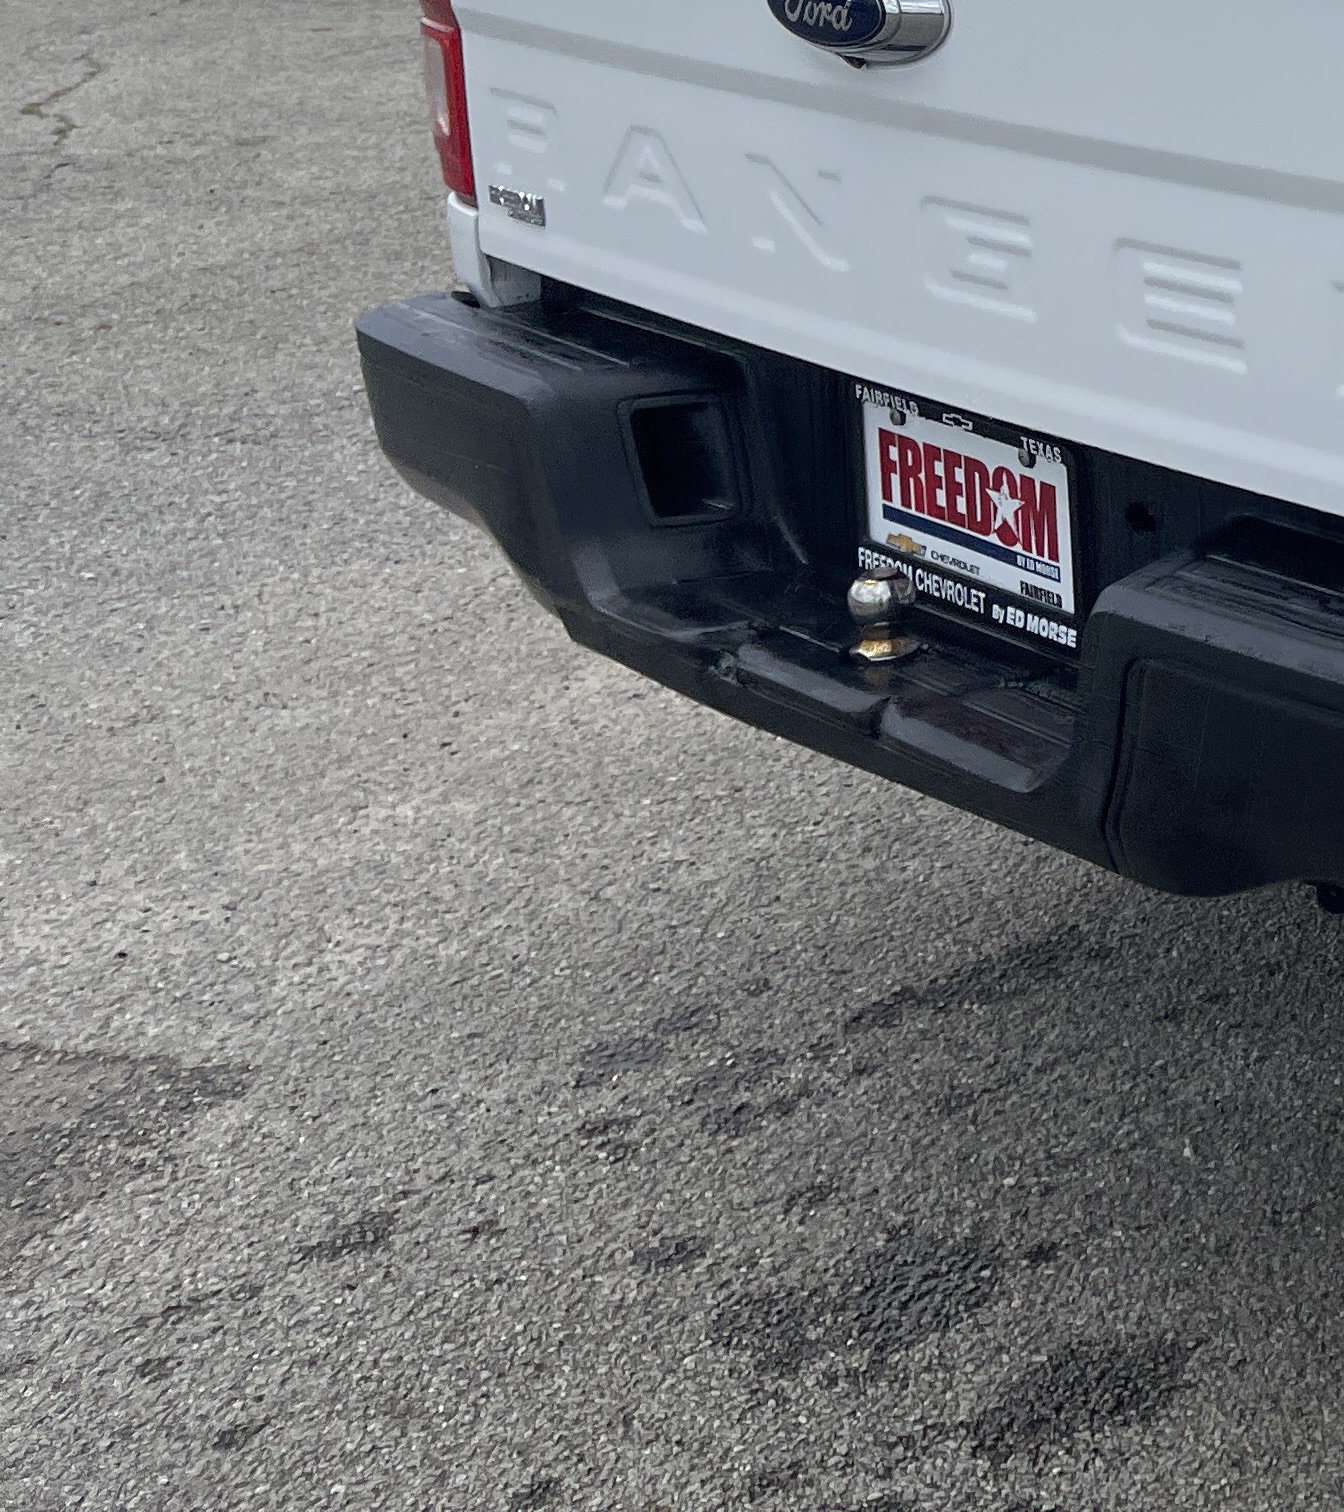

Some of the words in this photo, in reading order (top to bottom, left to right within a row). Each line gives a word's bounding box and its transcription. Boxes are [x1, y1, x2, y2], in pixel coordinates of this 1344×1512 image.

[855, 384, 919, 416] FAIRFIELD
[1020, 436, 1062, 463] TEXAS
[877, 427, 1060, 563] FREEDOM
[930, 550, 981, 576] CHEVROLET
[915, 568, 986, 614] CHEVROLET
[1006, 605, 1025, 629] ED
[1026, 612, 1078, 648] MORSE
[1019, 580, 1063, 609] FAIRFIELD
